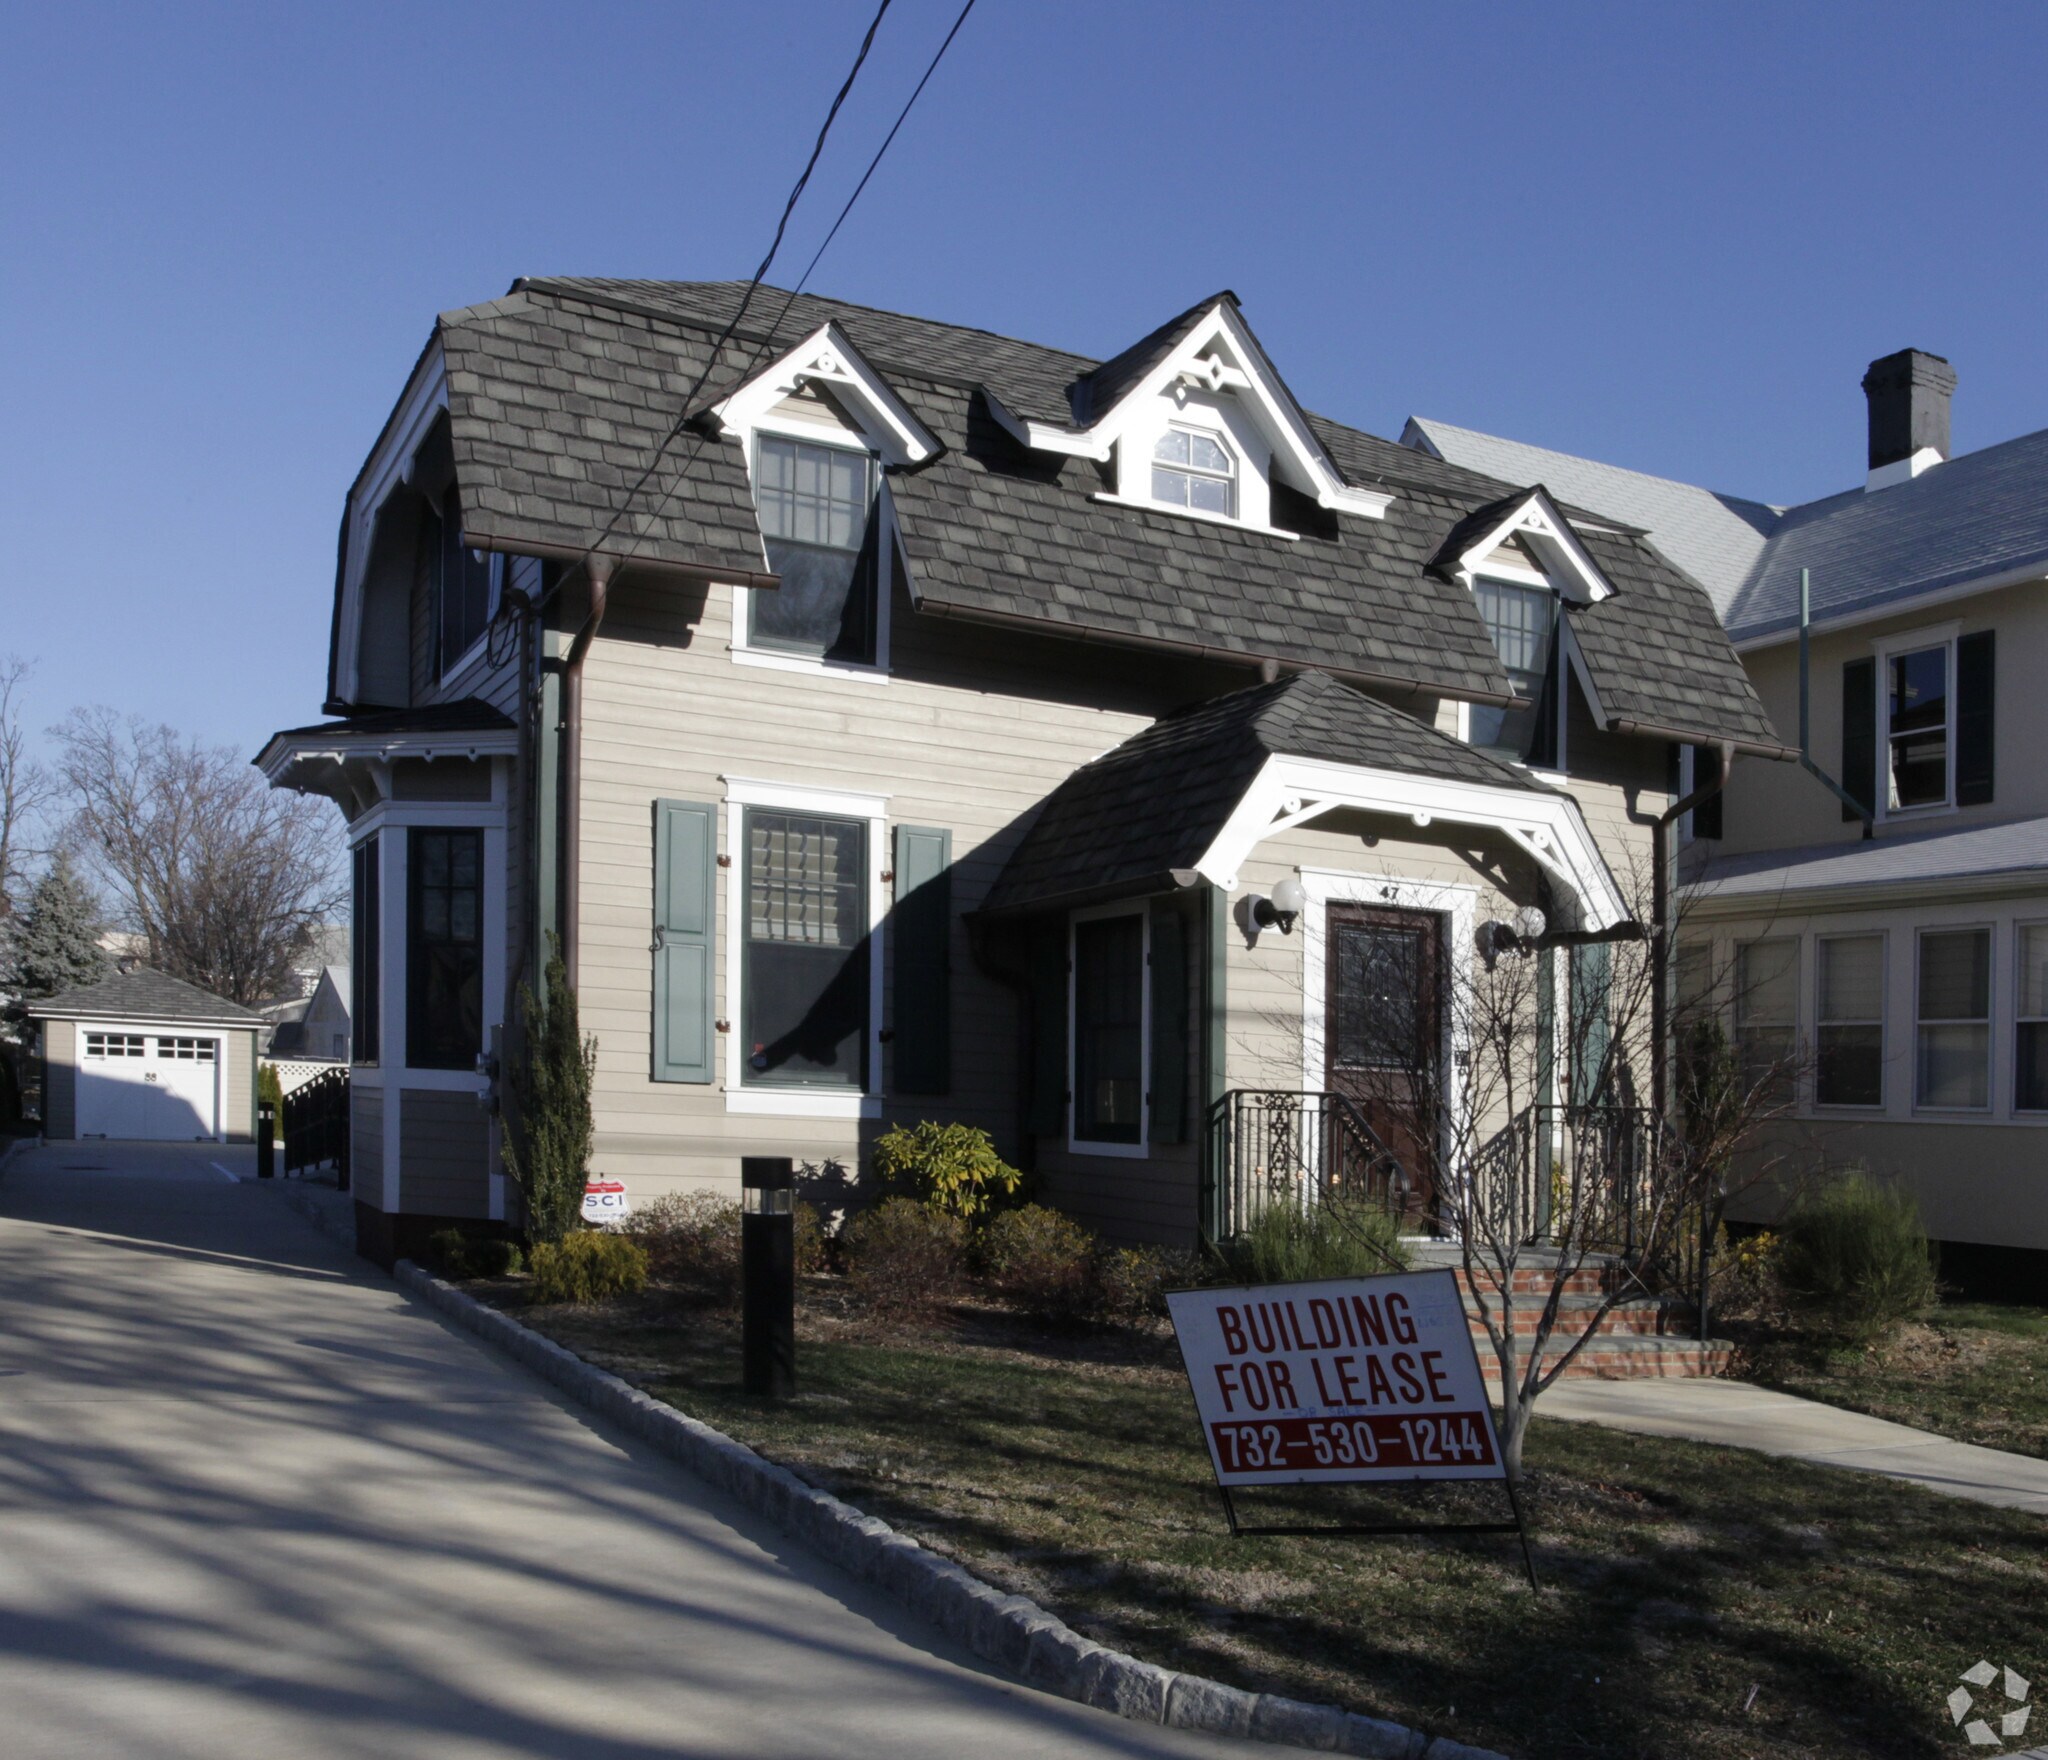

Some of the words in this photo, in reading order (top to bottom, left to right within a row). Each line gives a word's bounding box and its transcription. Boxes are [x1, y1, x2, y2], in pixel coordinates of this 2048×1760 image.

[1379, 885, 1400, 900] 47
[1216, 1292, 1419, 1356] BUILDING
[1214, 1360, 1299, 1413] FOR
[1310, 1351, 1455, 1408] LEASE
[1219, 1417, 1483, 1468] 732-530-1244
